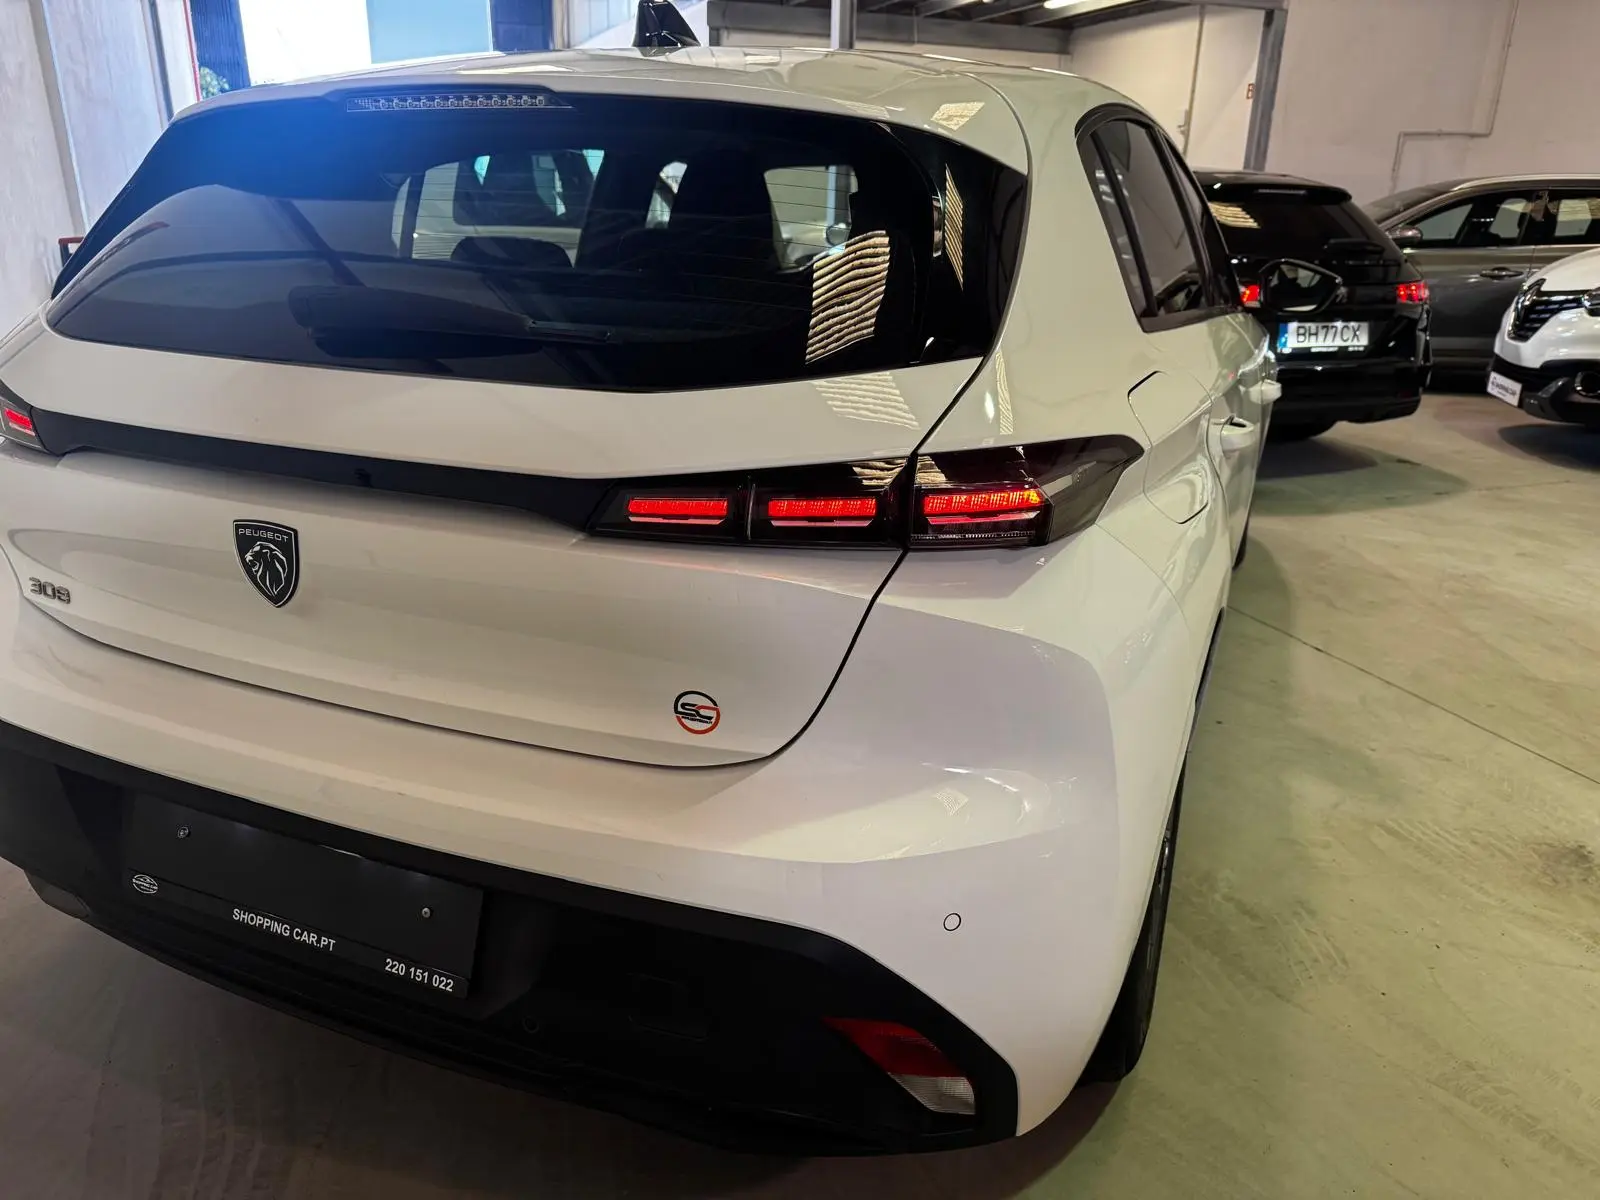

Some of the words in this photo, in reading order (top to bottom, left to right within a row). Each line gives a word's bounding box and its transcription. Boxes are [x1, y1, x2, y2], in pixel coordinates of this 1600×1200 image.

[238, 528, 289, 542] PEUGEOT
[232, 908, 291, 937] SHOPPING
[292, 928, 336, 951] CAR.PT
[384, 958, 406, 976] 220
[409, 967, 429, 984] 151
[432, 974, 454, 992] 022
